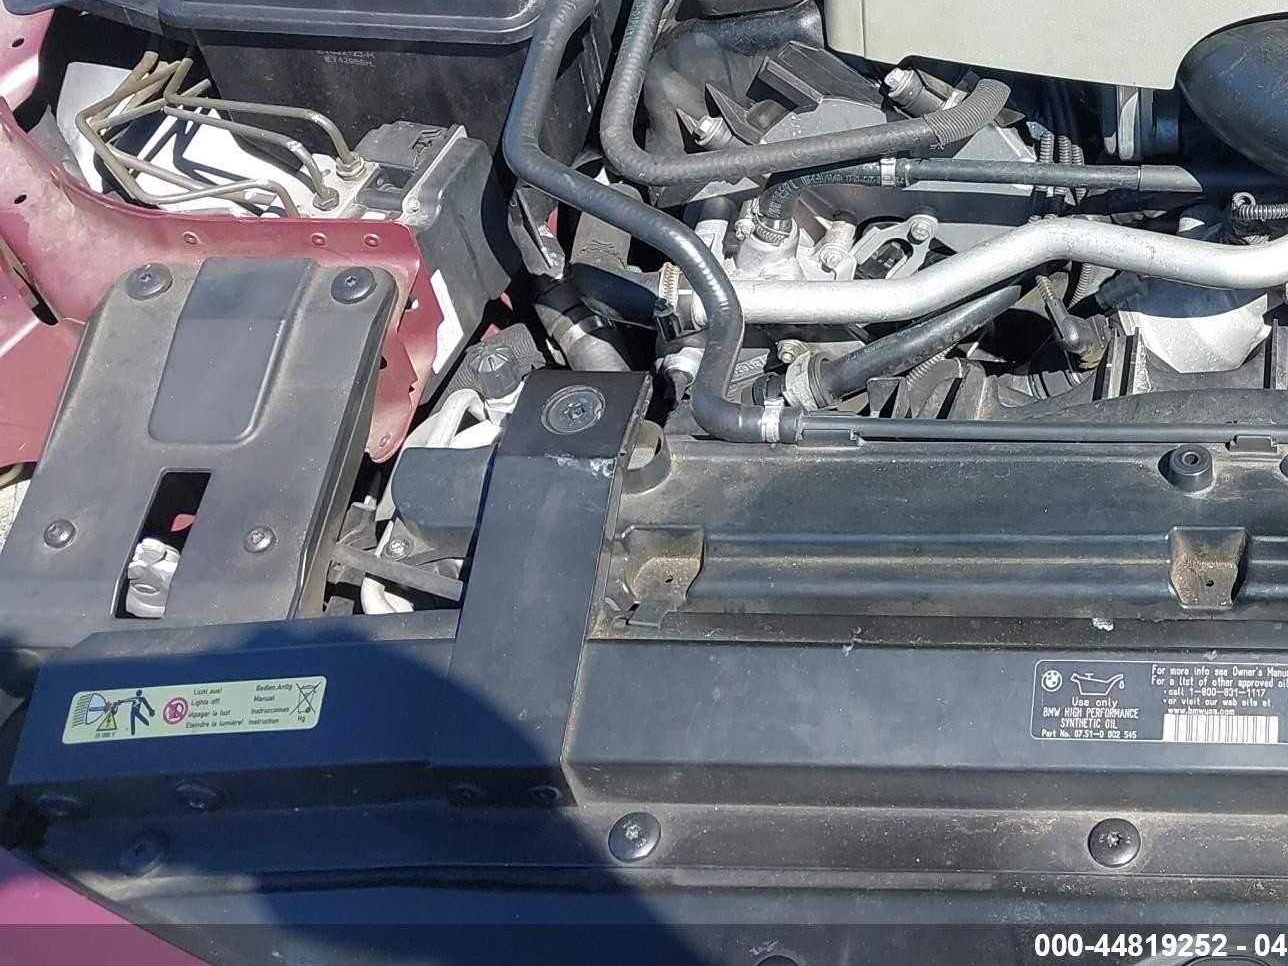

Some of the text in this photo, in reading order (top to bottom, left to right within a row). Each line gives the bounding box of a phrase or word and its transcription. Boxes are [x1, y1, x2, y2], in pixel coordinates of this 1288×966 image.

[1152, 666, 1166, 675] For
[1194, 666, 1209, 675] info
[1215, 668, 1227, 676] see
[1233, 667, 1262, 676] Owner's
[1151, 676, 1165, 685] For
[1179, 676, 1194, 686] list
[1198, 677, 1208, 686] of
[1212, 677, 1233, 687] other
[1238, 678, 1273, 689] approved
[1168, 687, 1266, 697] call 1-800-831-1117
[1072, 696, 1118, 708] Use only
[1181, 697, 1200, 705] visit
[1223, 698, 1237, 706] web
[1242, 698, 1258, 707] site
[1262, 699, 1271, 707] at
[1043, 707, 1139, 718] BMW HIGH PERFORMANCE
[1168, 707, 1235, 715] www.bmwusa.com
[1060, 718, 1117, 729] SYNTHETIC OIL
[1041, 729, 1056, 737] Part
